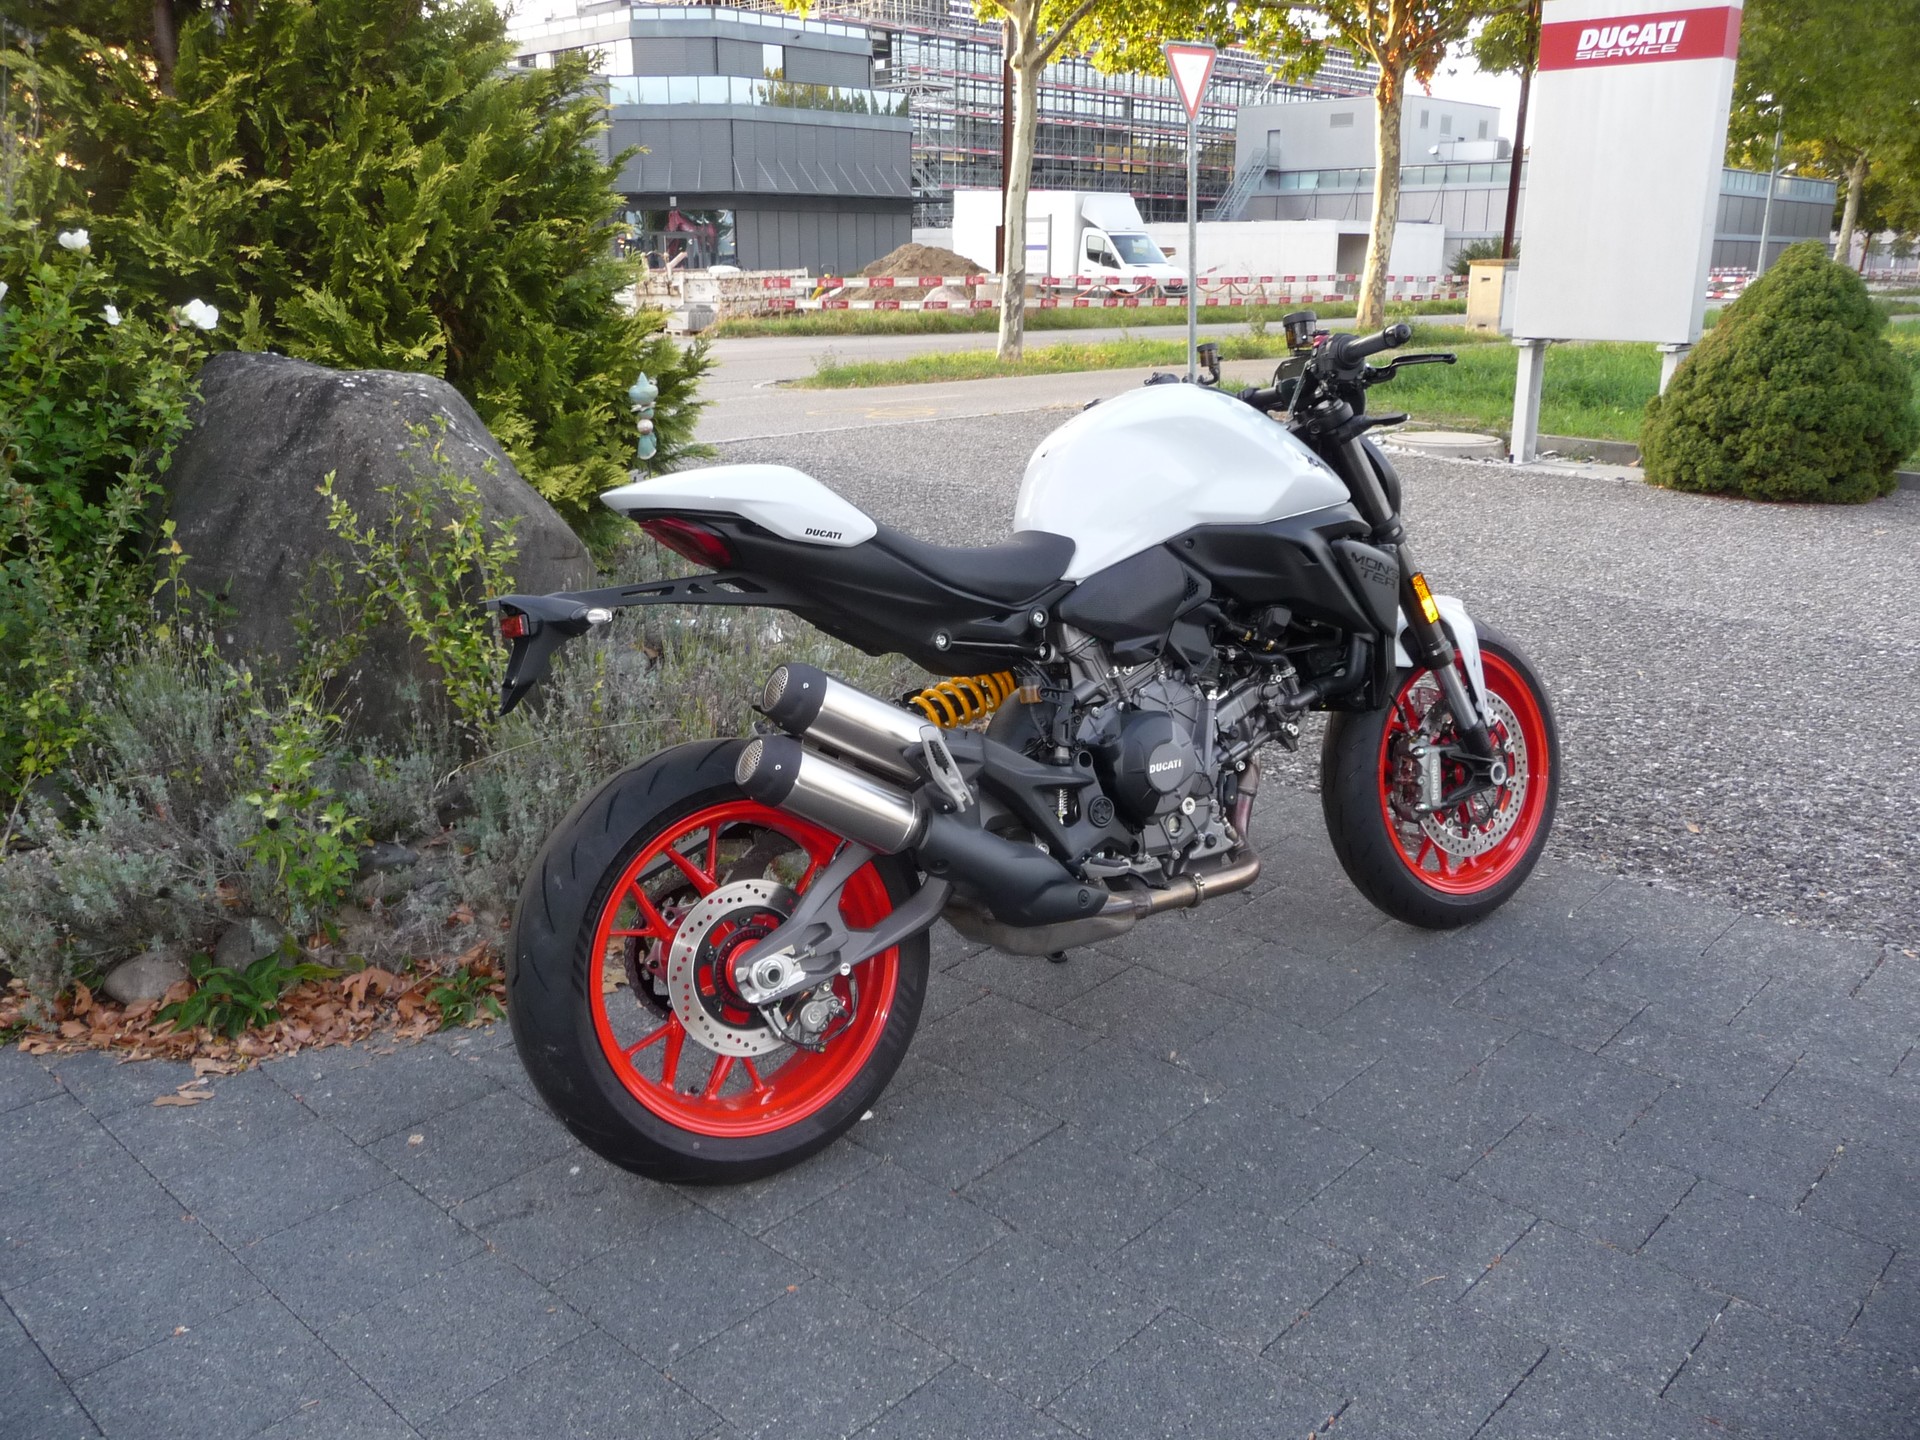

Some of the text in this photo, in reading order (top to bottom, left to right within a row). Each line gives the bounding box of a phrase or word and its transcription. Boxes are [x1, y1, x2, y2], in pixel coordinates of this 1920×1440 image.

[1577, 20, 1686, 51] DUCATI
[1575, 43, 1679, 60] SERVICE
[804, 527, 842, 540] DUCATI
[1149, 759, 1182, 774] DUCATI
[1431, 759, 1439, 800] brembo
